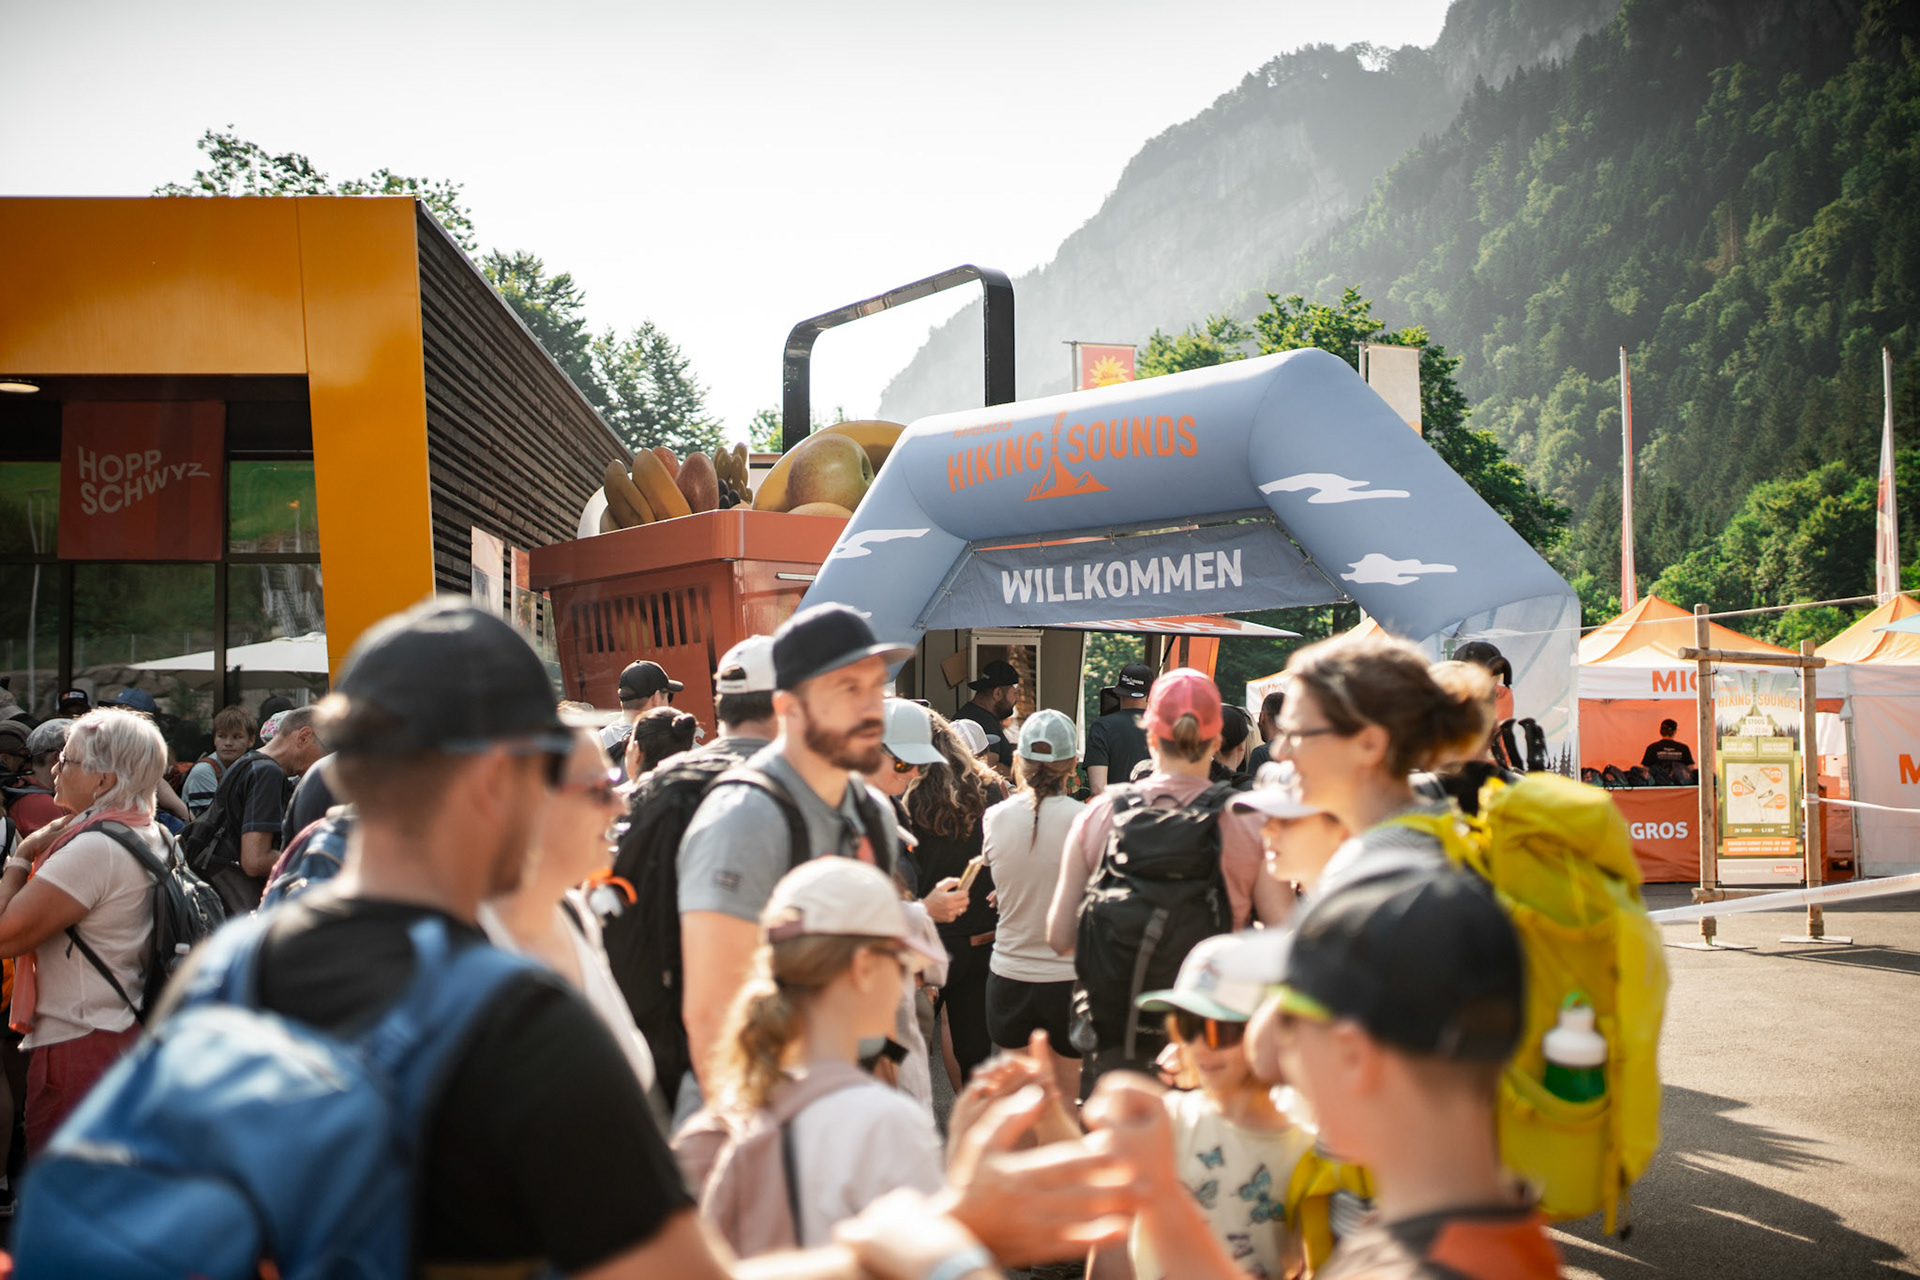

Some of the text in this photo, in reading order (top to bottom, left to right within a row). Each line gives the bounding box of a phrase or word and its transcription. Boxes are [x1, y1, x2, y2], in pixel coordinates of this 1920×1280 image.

[78, 445, 161, 482] HOPP
[947, 414, 1198, 492] HIKING SOUNDS
[80, 462, 210, 515] SCHWYZ
[1001, 549, 1242, 604] WILLKOMMEN
[1718, 693, 1797, 709] HIKING SOUNDS
[1627, 821, 1689, 840] GROS
